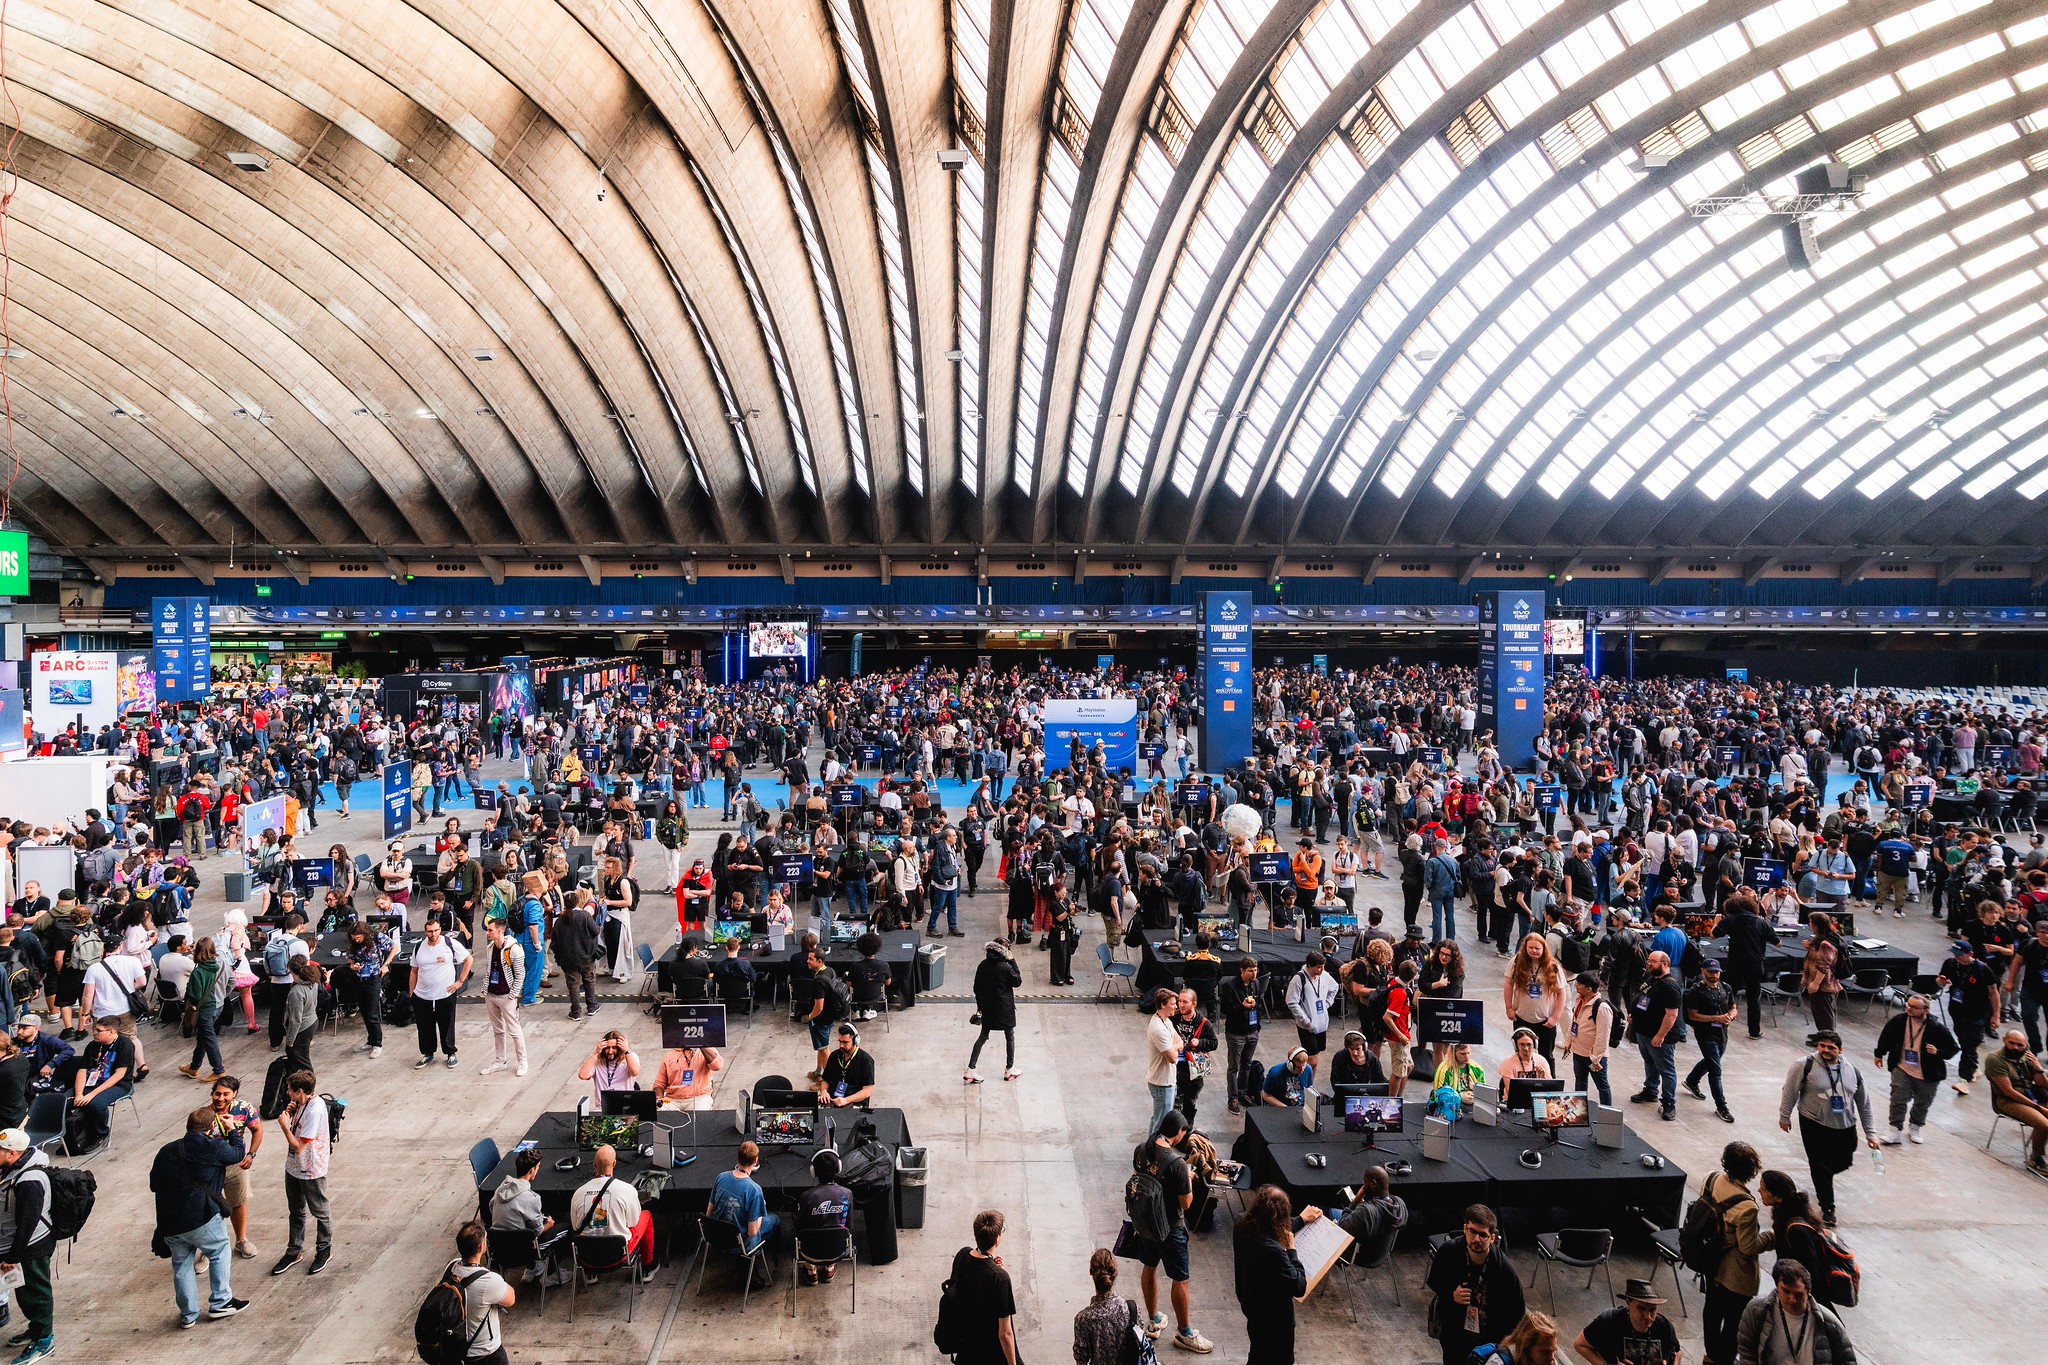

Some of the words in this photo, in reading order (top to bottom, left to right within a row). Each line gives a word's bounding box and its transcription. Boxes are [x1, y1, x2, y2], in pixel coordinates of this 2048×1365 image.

[1210, 624, 1249, 633] TOURNAMENT
[1502, 623, 1541, 632] TOURNAMENT
[1221, 632, 1237, 640] AREA
[1513, 631, 1529, 639] AREA
[53, 660, 85, 671] ARC
[429, 680, 453, 688] CyStore
[841, 794, 852, 802] 222
[1187, 793, 1198, 801] 232
[1542, 796, 1552, 804] 242
[1892, 850, 1901, 861] 3
[786, 867, 800, 877] 223
[1262, 865, 1277, 875] 233
[306, 871, 320, 881] 213
[1756, 872, 1771, 882] 243
[1440, 1019, 1462, 1034] 234
[683, 1025, 705, 1038] 224
